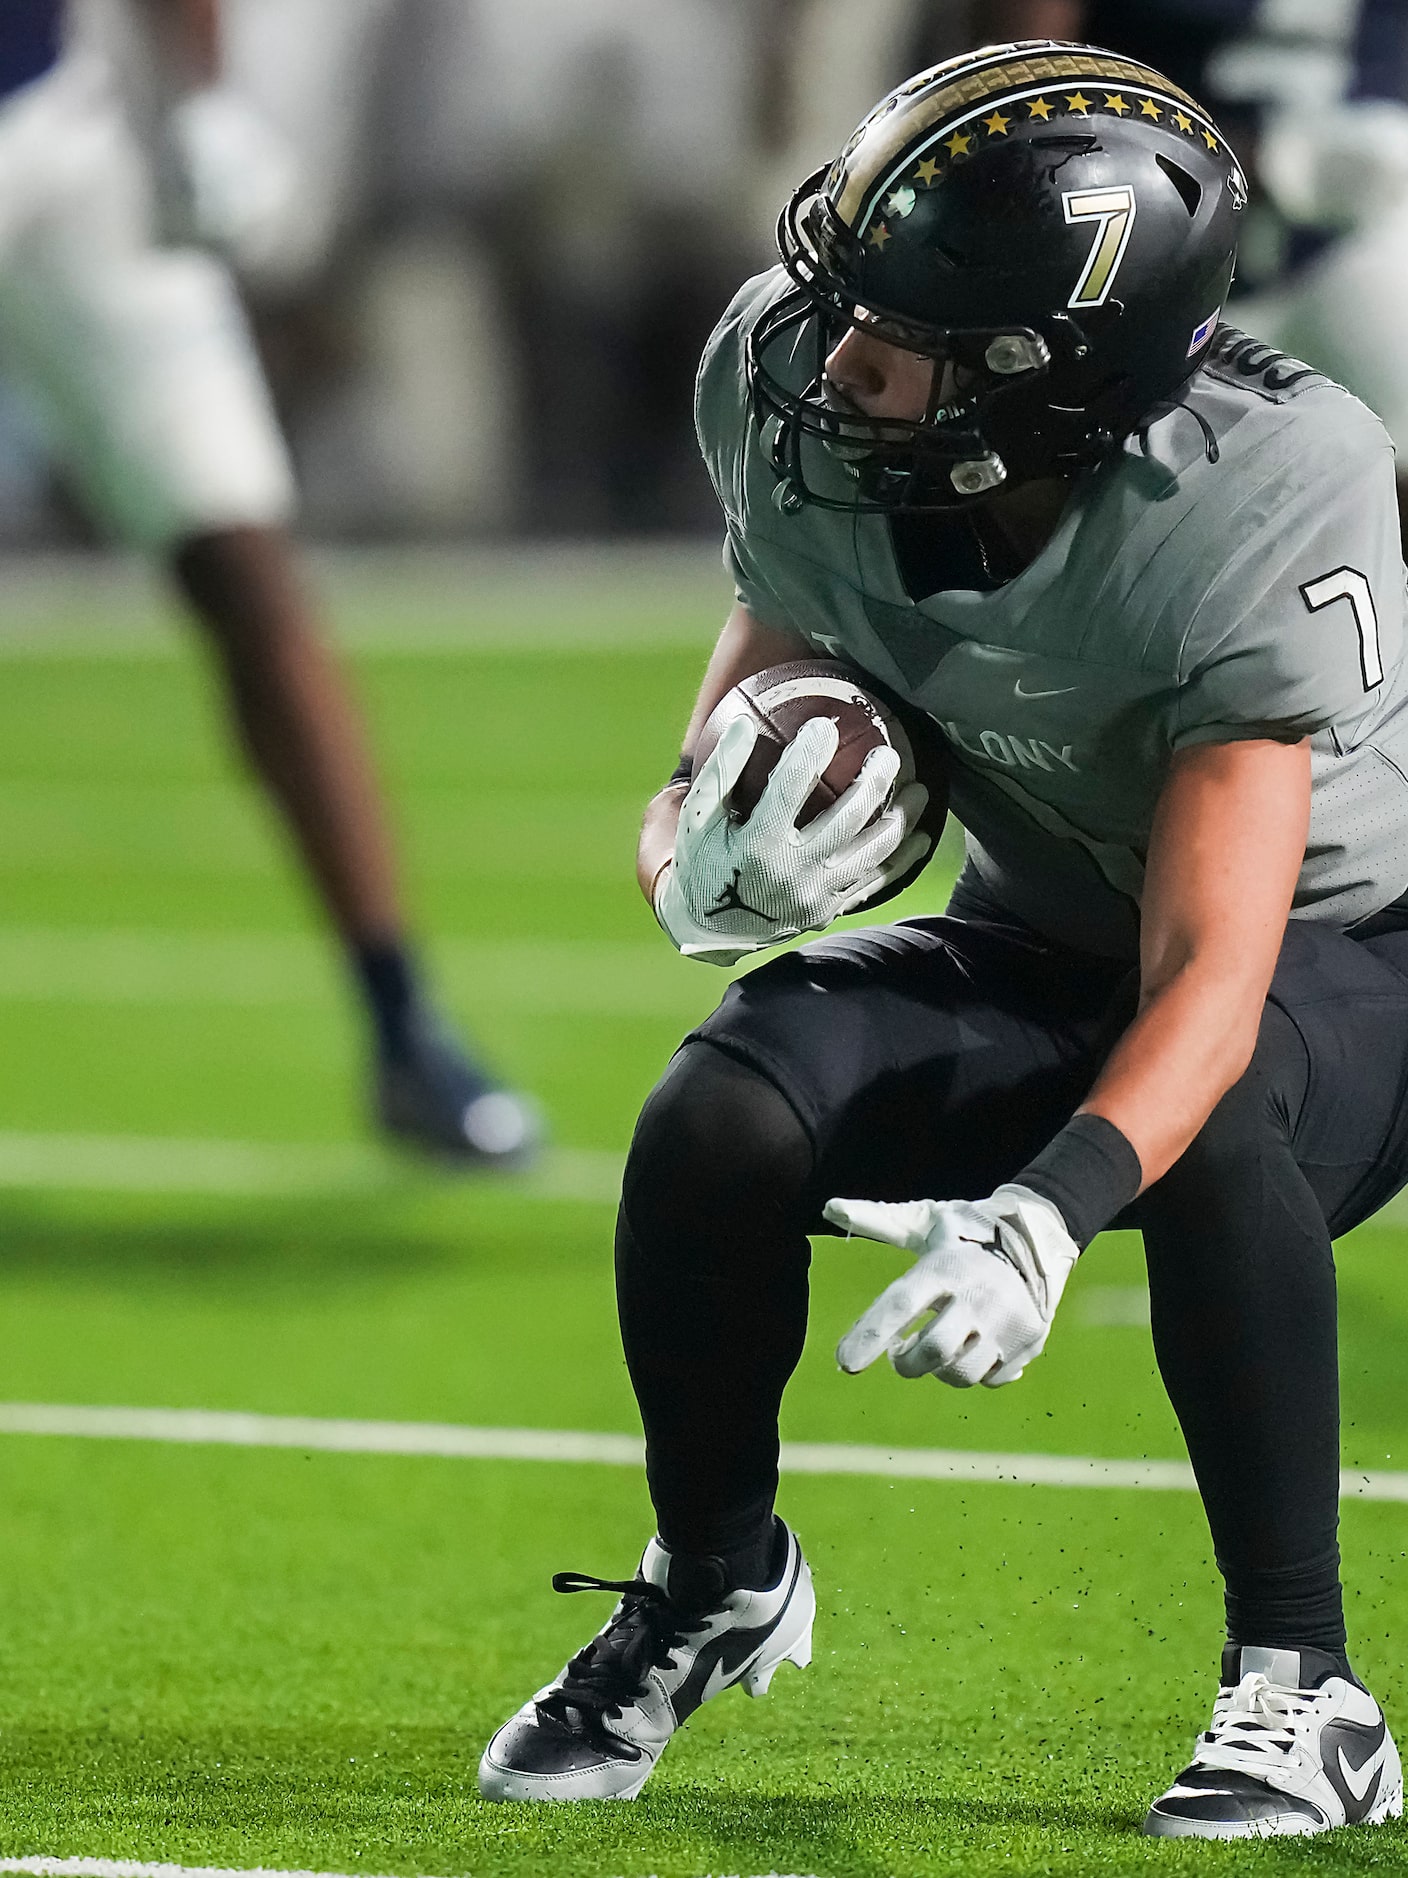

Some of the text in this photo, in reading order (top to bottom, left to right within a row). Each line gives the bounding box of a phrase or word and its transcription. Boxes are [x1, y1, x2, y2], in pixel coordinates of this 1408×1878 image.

[1061, 184, 1136, 308] 7
[1298, 565, 1385, 693] 7
[927, 711, 1080, 772] LONY
